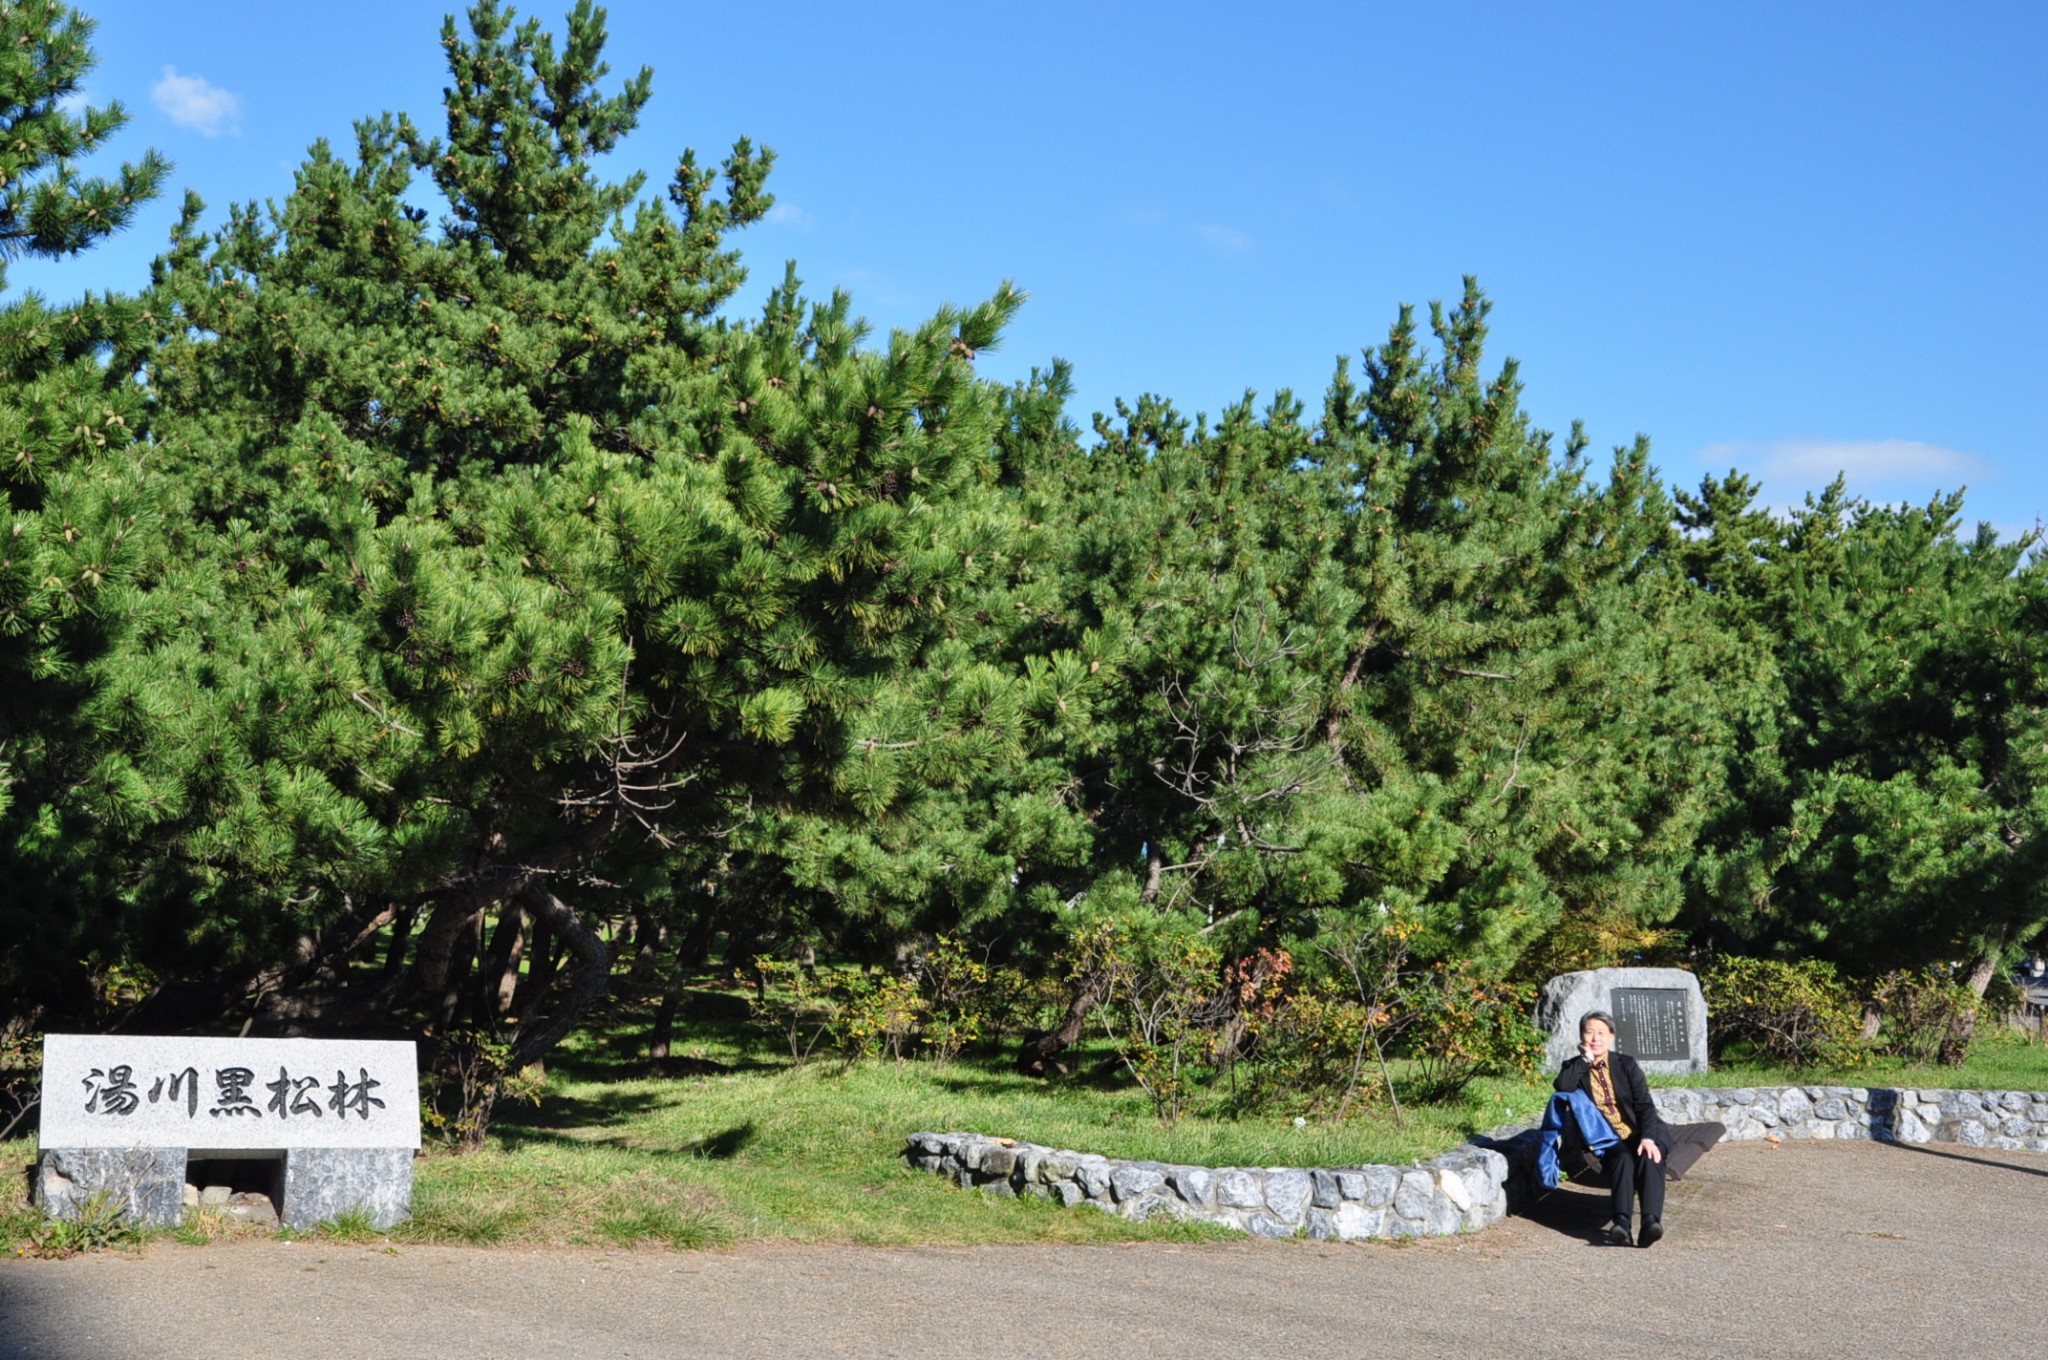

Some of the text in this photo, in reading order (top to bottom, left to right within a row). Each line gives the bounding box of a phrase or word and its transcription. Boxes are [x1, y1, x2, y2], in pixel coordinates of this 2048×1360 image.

[81, 1064, 386, 1120] 湯川黒松林
